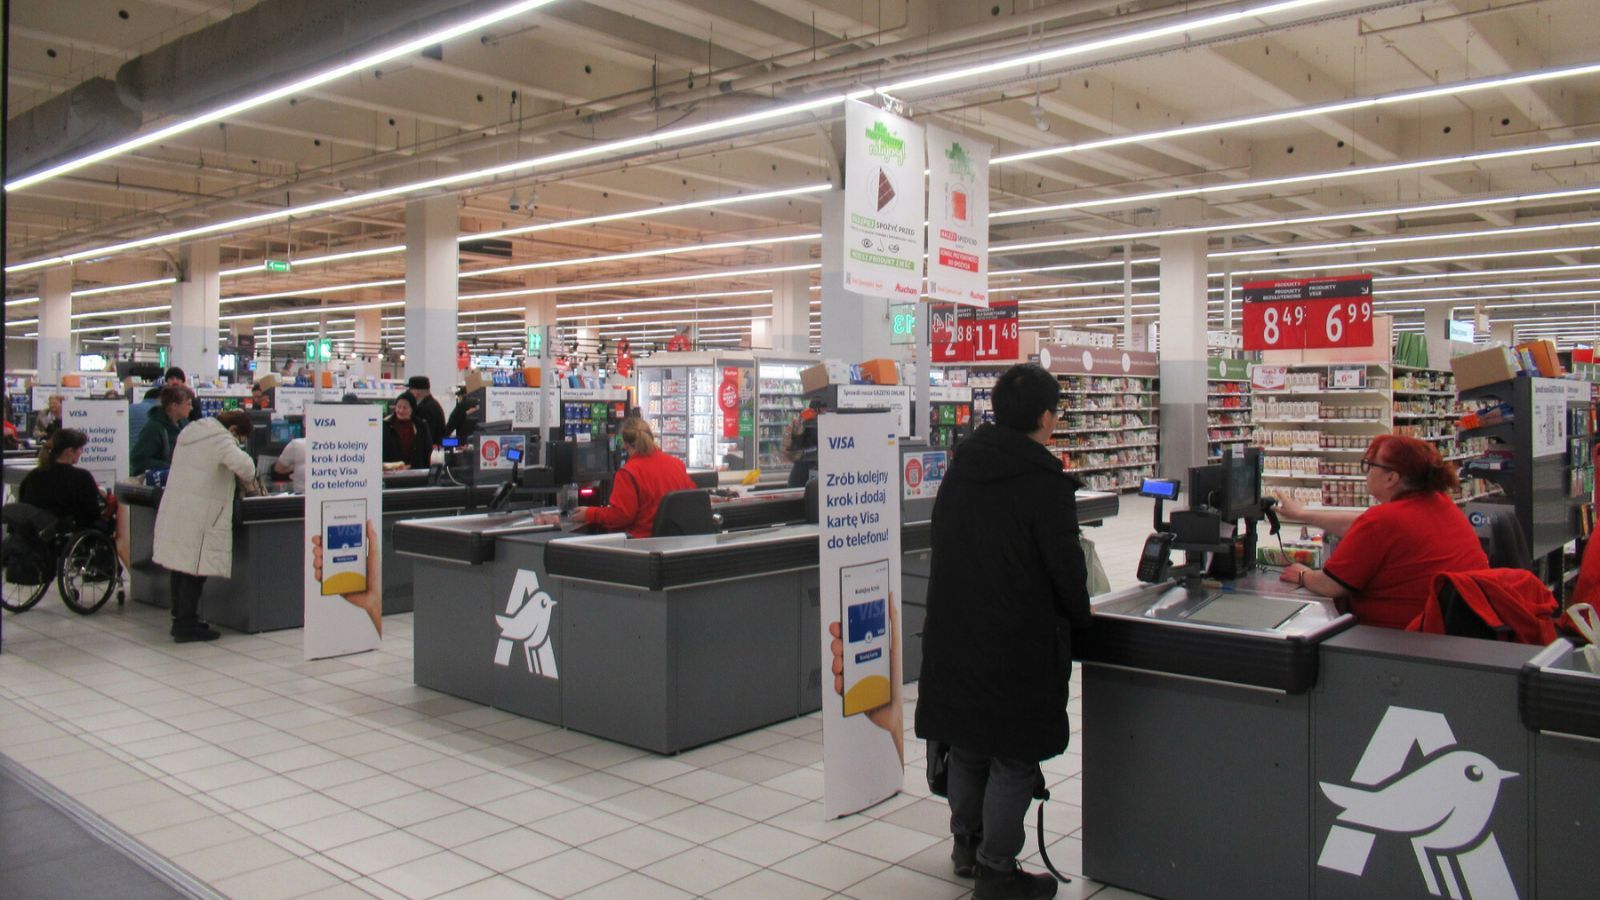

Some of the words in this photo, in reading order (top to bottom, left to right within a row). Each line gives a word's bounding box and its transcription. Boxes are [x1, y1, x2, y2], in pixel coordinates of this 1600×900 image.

[895, 282, 918, 295] Auchan
[1263, 307, 1279, 344] 8
[1282, 306, 1304, 326] 49
[1326, 304, 1342, 342] 6
[1347, 302, 1371, 323] 99
[957, 325, 973, 341] 88
[976, 324, 998, 356] 11
[1002, 322, 1018, 340] 48
[313, 418, 336, 427] VISA
[311, 441, 336, 450] Zrób
[338, 441, 368, 451] kolejny
[827, 436, 855, 449] VISA
[311, 454, 333, 463] krok
[336, 454, 339, 462] i
[340, 453, 365, 464] dodaj
[311, 467, 337, 477] kartę
[339, 467, 358, 475] Visa
[826, 472, 855, 487] Zrób
[857, 469, 889, 485] kolejny
[311, 480, 325, 489] do
[327, 478, 368, 488] telefonu!
[826, 492, 854, 507] krok
[855, 492, 859, 504] i
[860, 489, 886, 504] dodaj
[827, 514, 858, 529] kartę
[860, 511, 880, 525] Visa
[827, 536, 844, 549] do
[846, 528, 889, 547] telefonu!
